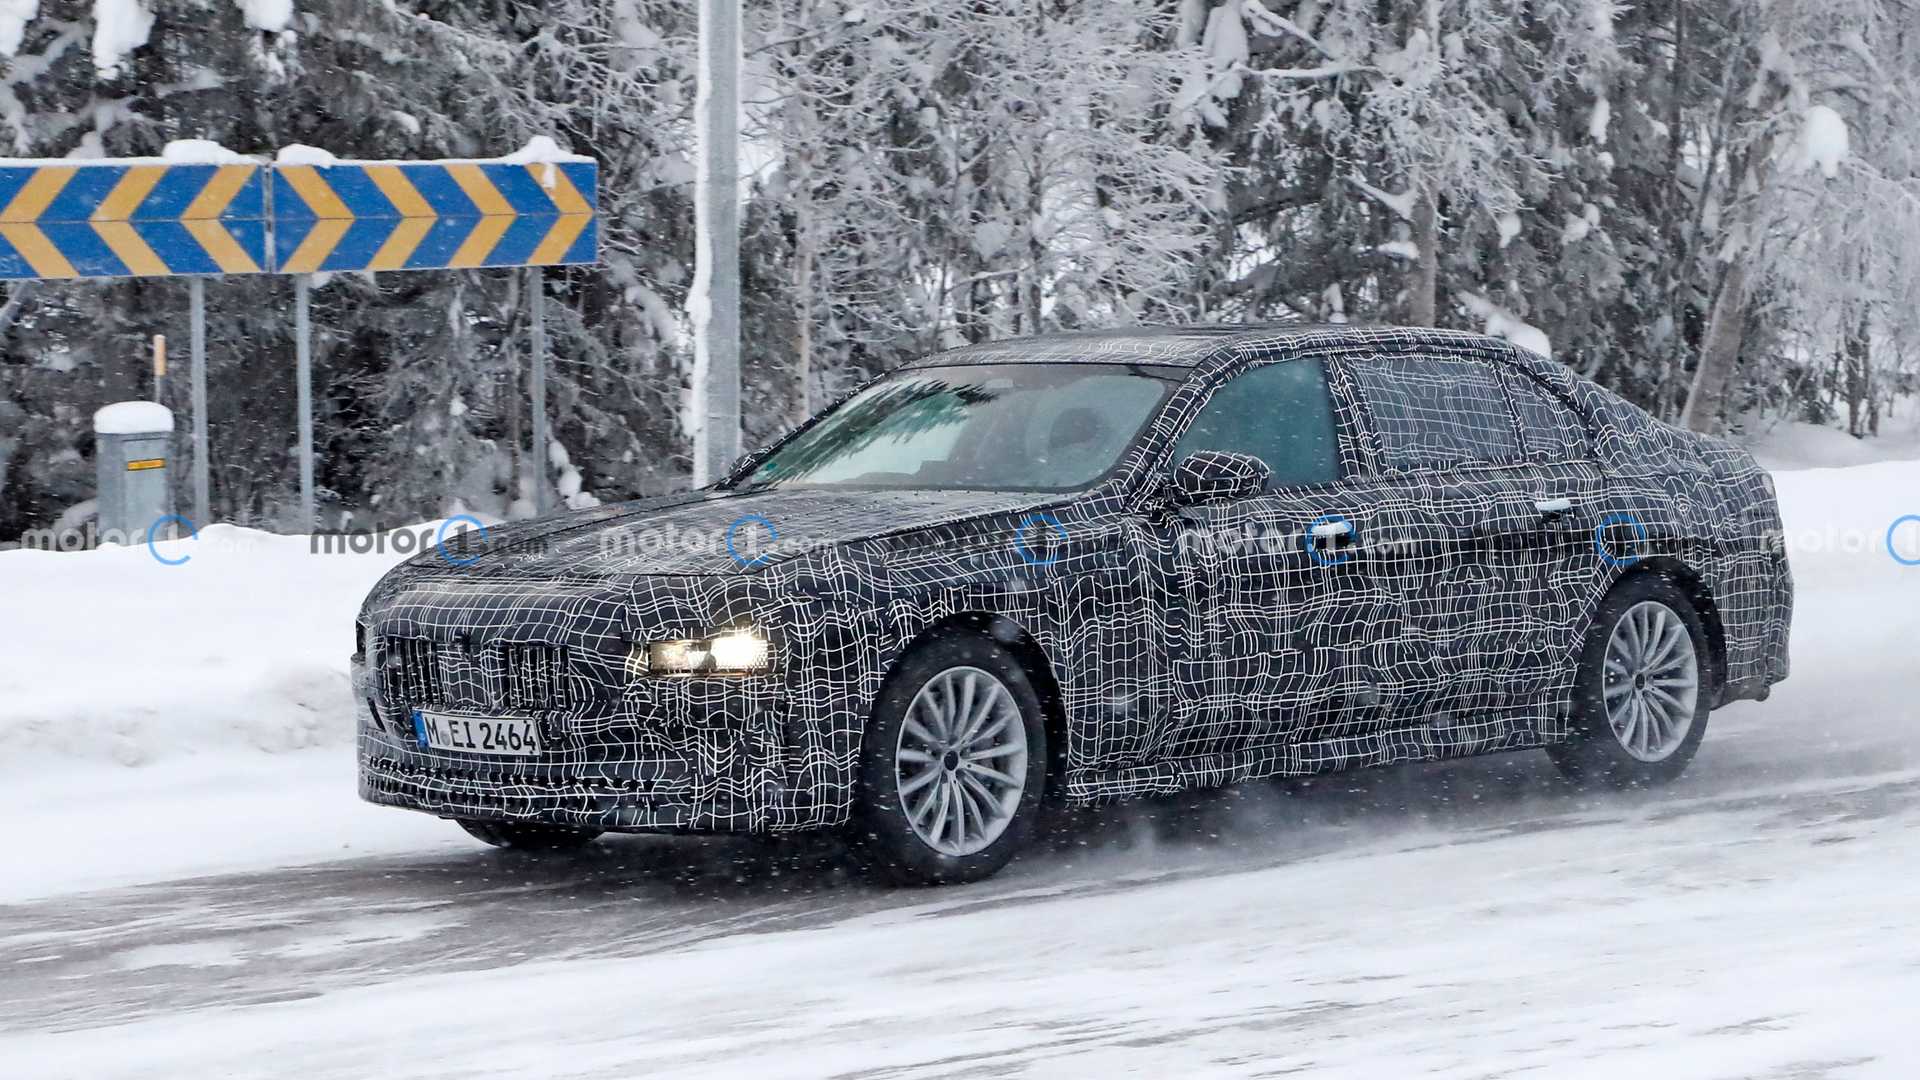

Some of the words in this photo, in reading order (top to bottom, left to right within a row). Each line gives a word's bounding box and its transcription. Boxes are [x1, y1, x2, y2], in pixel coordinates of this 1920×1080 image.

[425, 716, 441, 745] M
[449, 720, 476, 749] EI
[480, 722, 536, 751] 2464
